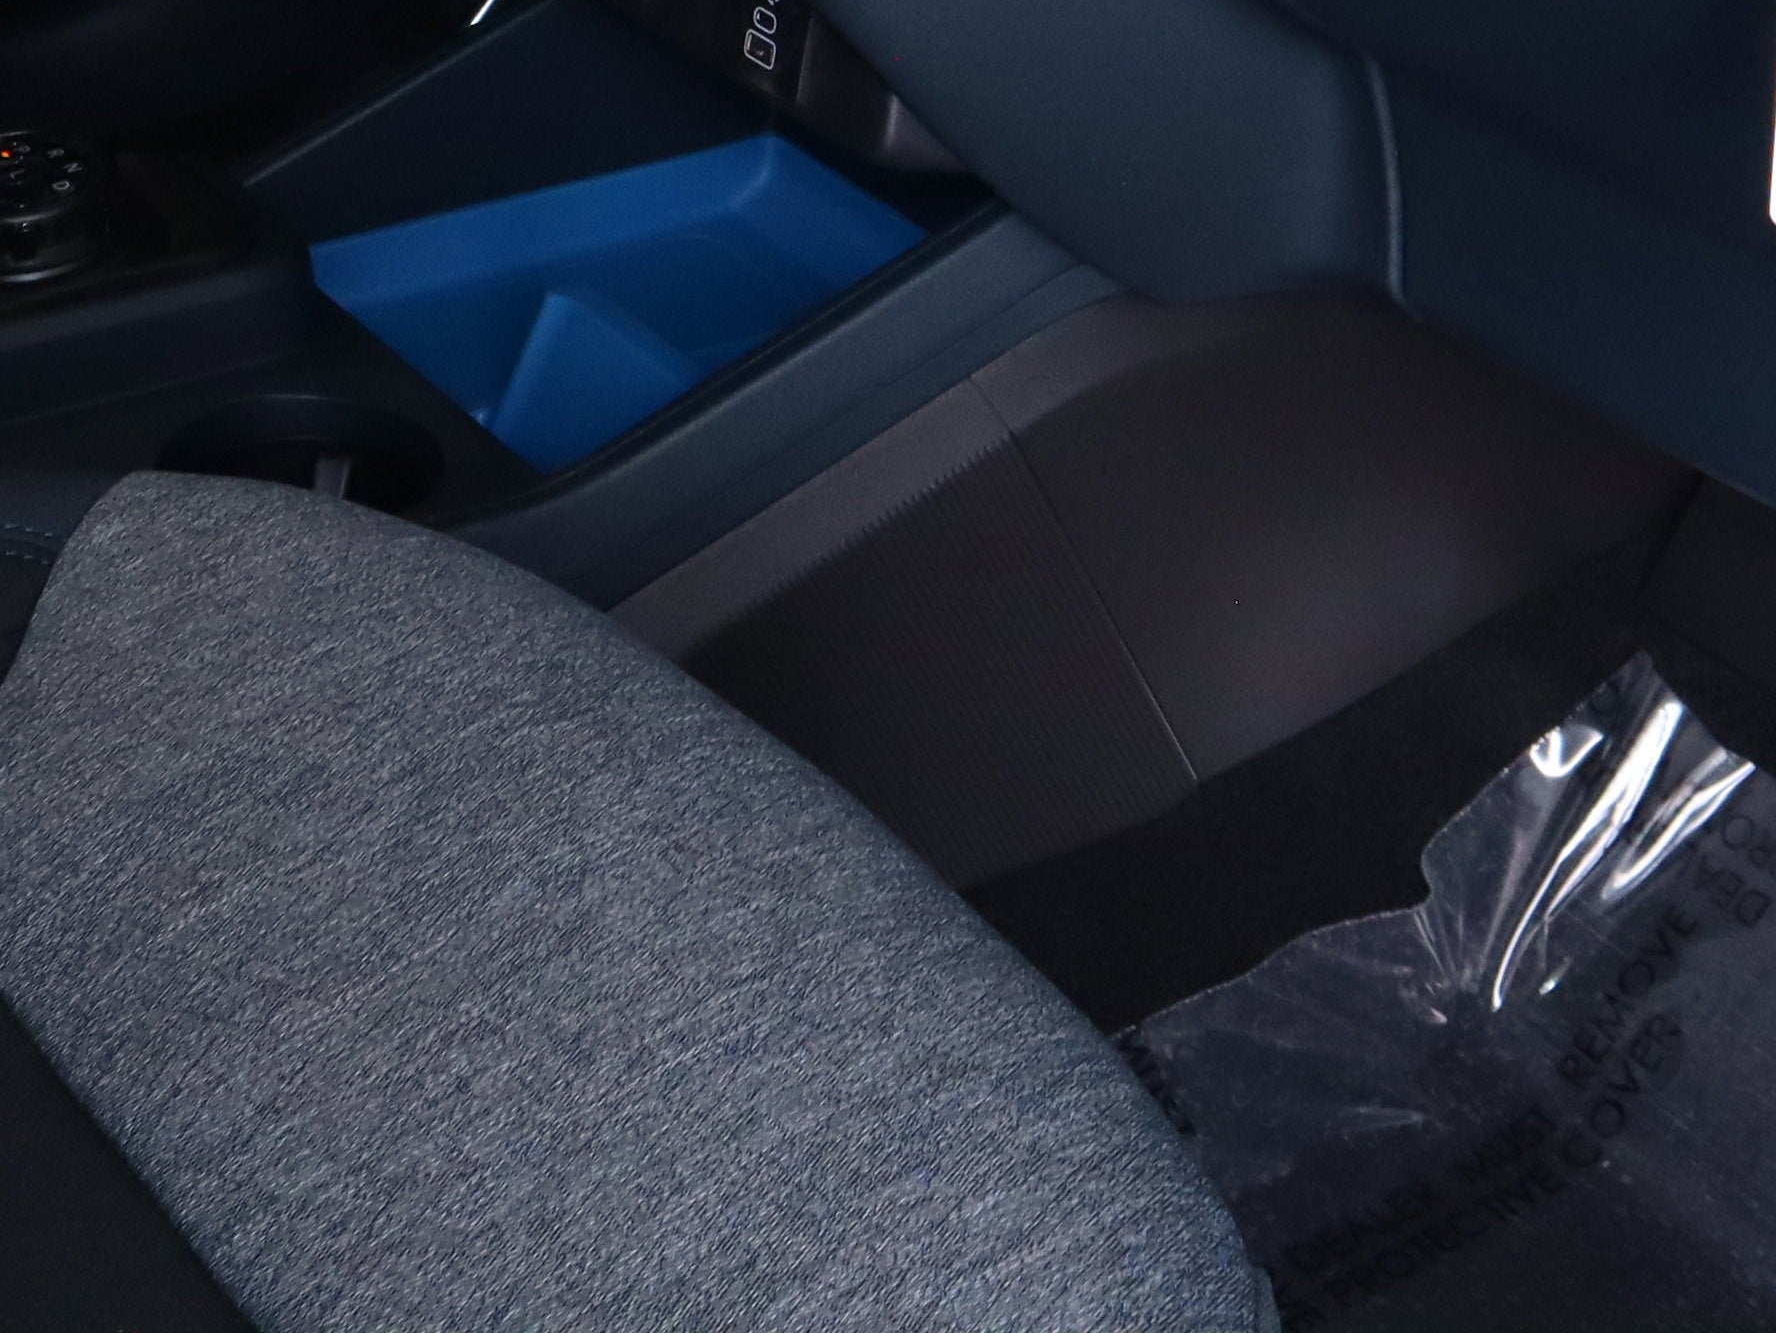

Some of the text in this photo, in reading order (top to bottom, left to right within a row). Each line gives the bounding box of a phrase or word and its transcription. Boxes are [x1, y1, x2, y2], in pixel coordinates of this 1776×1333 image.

[1284, 1181, 1446, 1277] DEALER
[1557, 903, 1697, 1090] REMOVE
[1561, 1013, 1682, 1171] COVER
